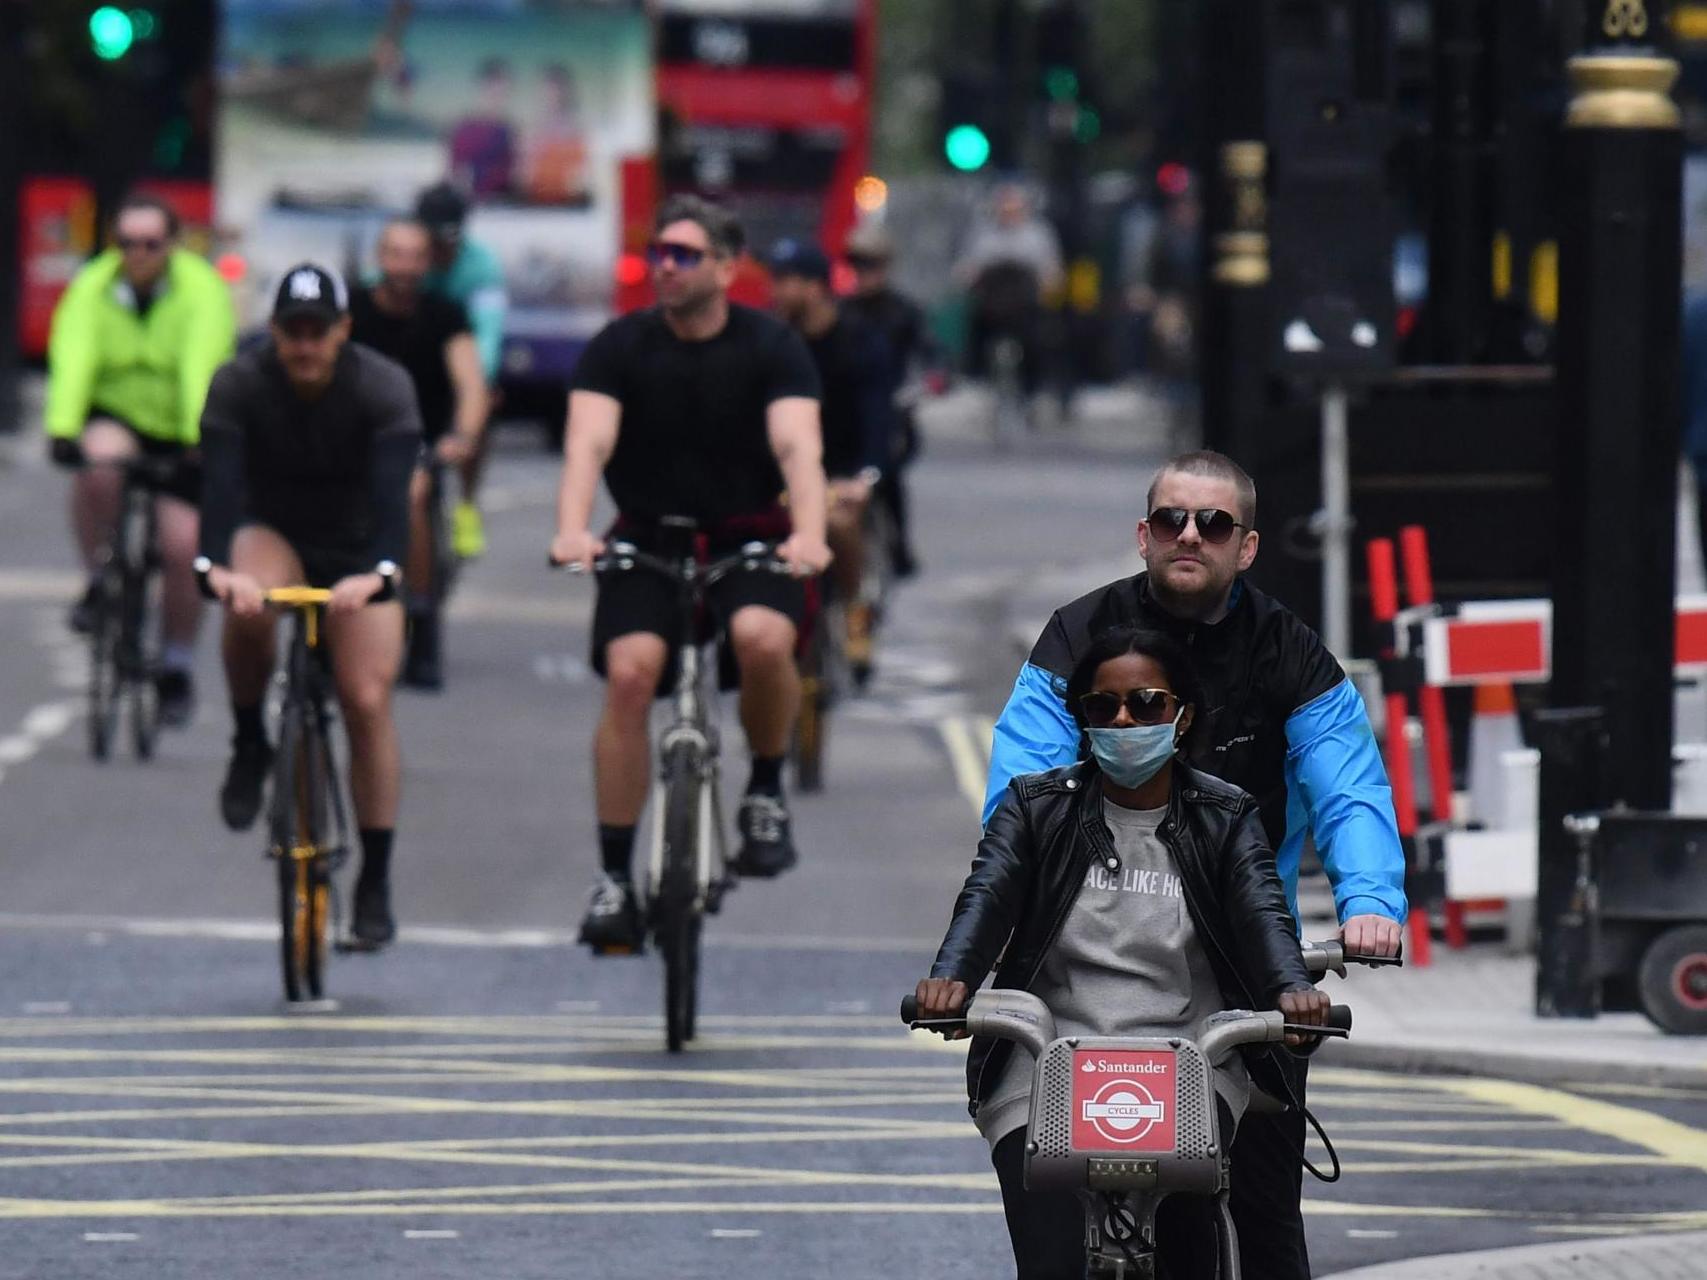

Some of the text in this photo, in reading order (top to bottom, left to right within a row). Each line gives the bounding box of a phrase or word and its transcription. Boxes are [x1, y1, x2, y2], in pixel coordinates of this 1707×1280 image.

[1123, 869, 1159, 894] LIKE
[1098, 1060, 1167, 1073] Santander
[1108, 1107, 1139, 1115] CYCLES
